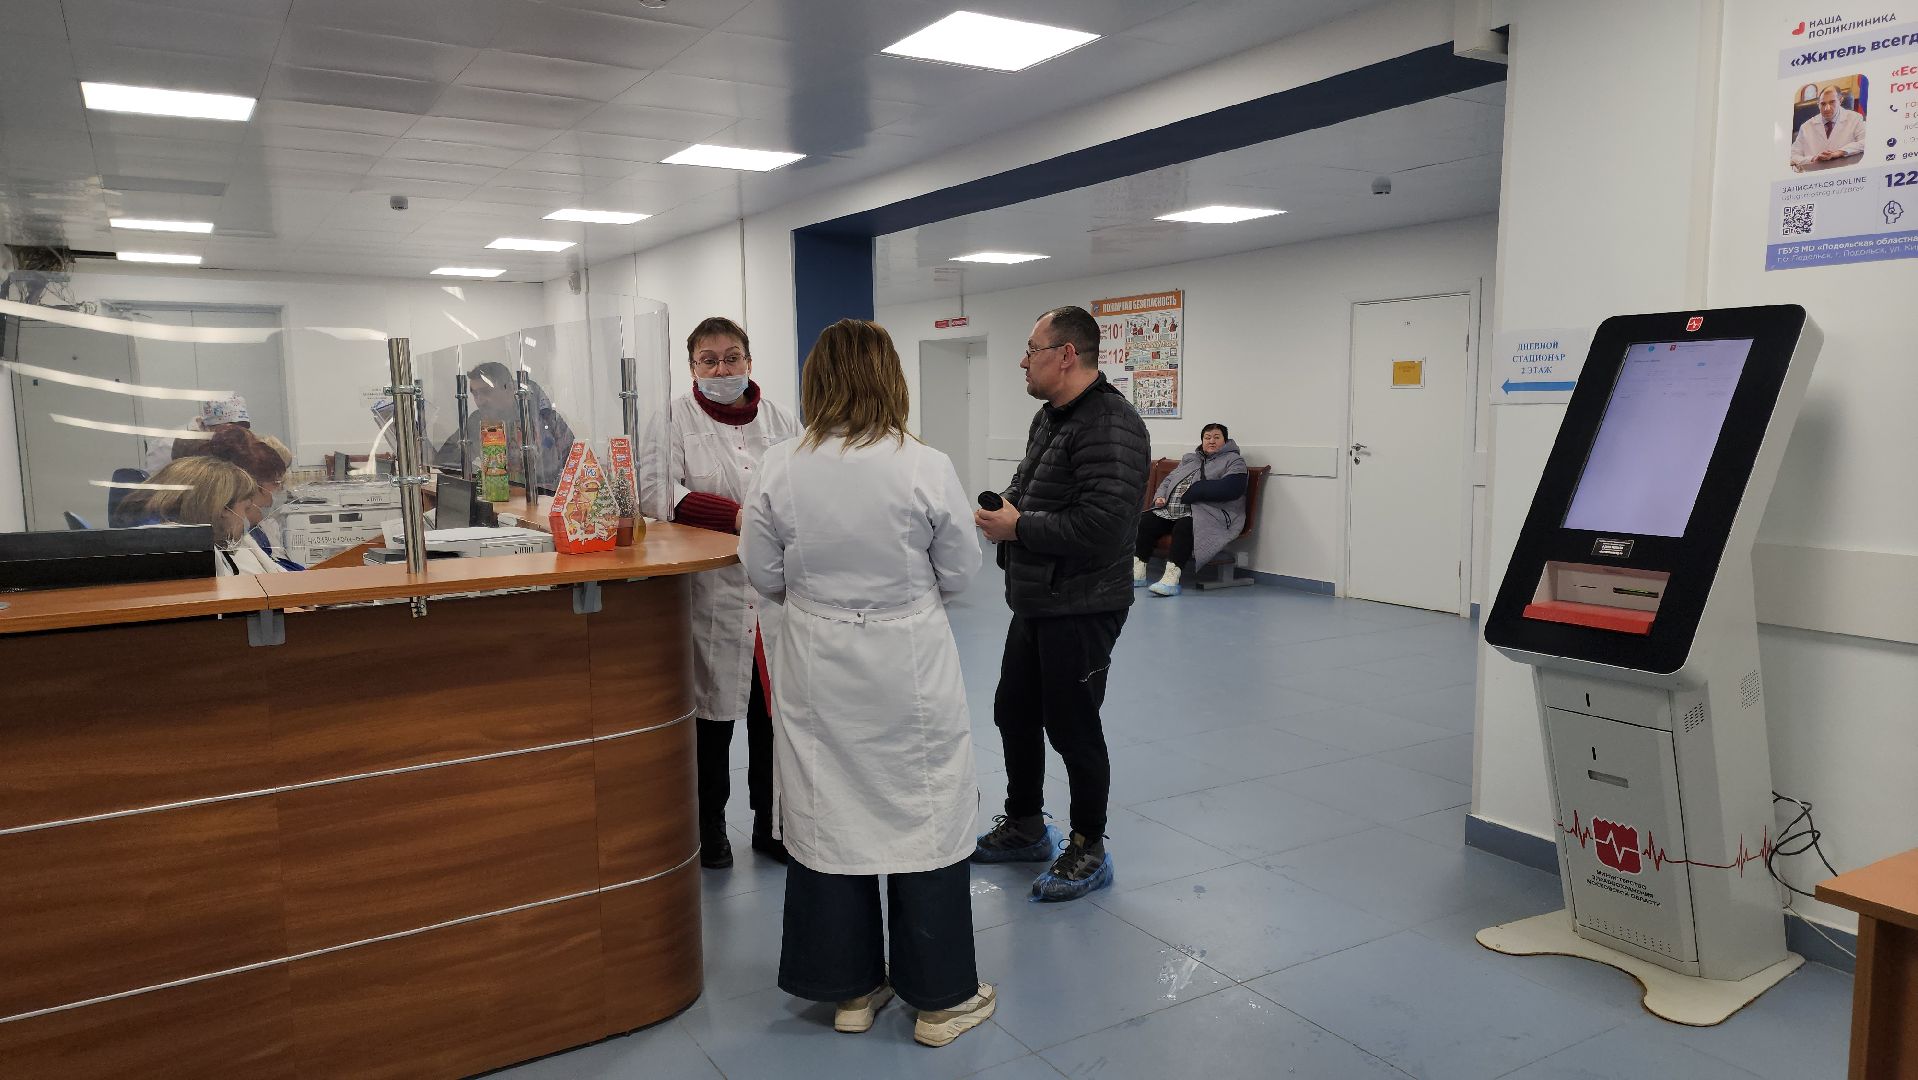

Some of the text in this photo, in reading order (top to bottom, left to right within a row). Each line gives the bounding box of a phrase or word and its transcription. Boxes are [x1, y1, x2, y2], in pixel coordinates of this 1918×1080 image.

[1808, 13, 1897, 39] ПОЛИКЛИНИКА
[1809, 14, 1842, 28] НАША
[1790, 44, 1867, 67] «Житель
[1782, 176, 1867, 194] ЗАПИСАТЬСЯ ONLINE
[1885, 170, 1918, 188] 122
[1778, 245, 1800, 256] ГБУЗ
[1801, 245, 1815, 254] МО
[1817, 240, 1874, 251] «Подольская
[1132, 294, 1177, 310] БЕЗОПАСНОСТЬ
[1107, 323, 1123, 340] 101
[1517, 340, 1559, 352] ДНЕВНОЙ
[1512, 353, 1566, 363] СТАЦИОНАР
[1528, 366, 1552, 375] ЭТАЖ
[1630, 893, 1661, 907] ОБЛАСТИ
